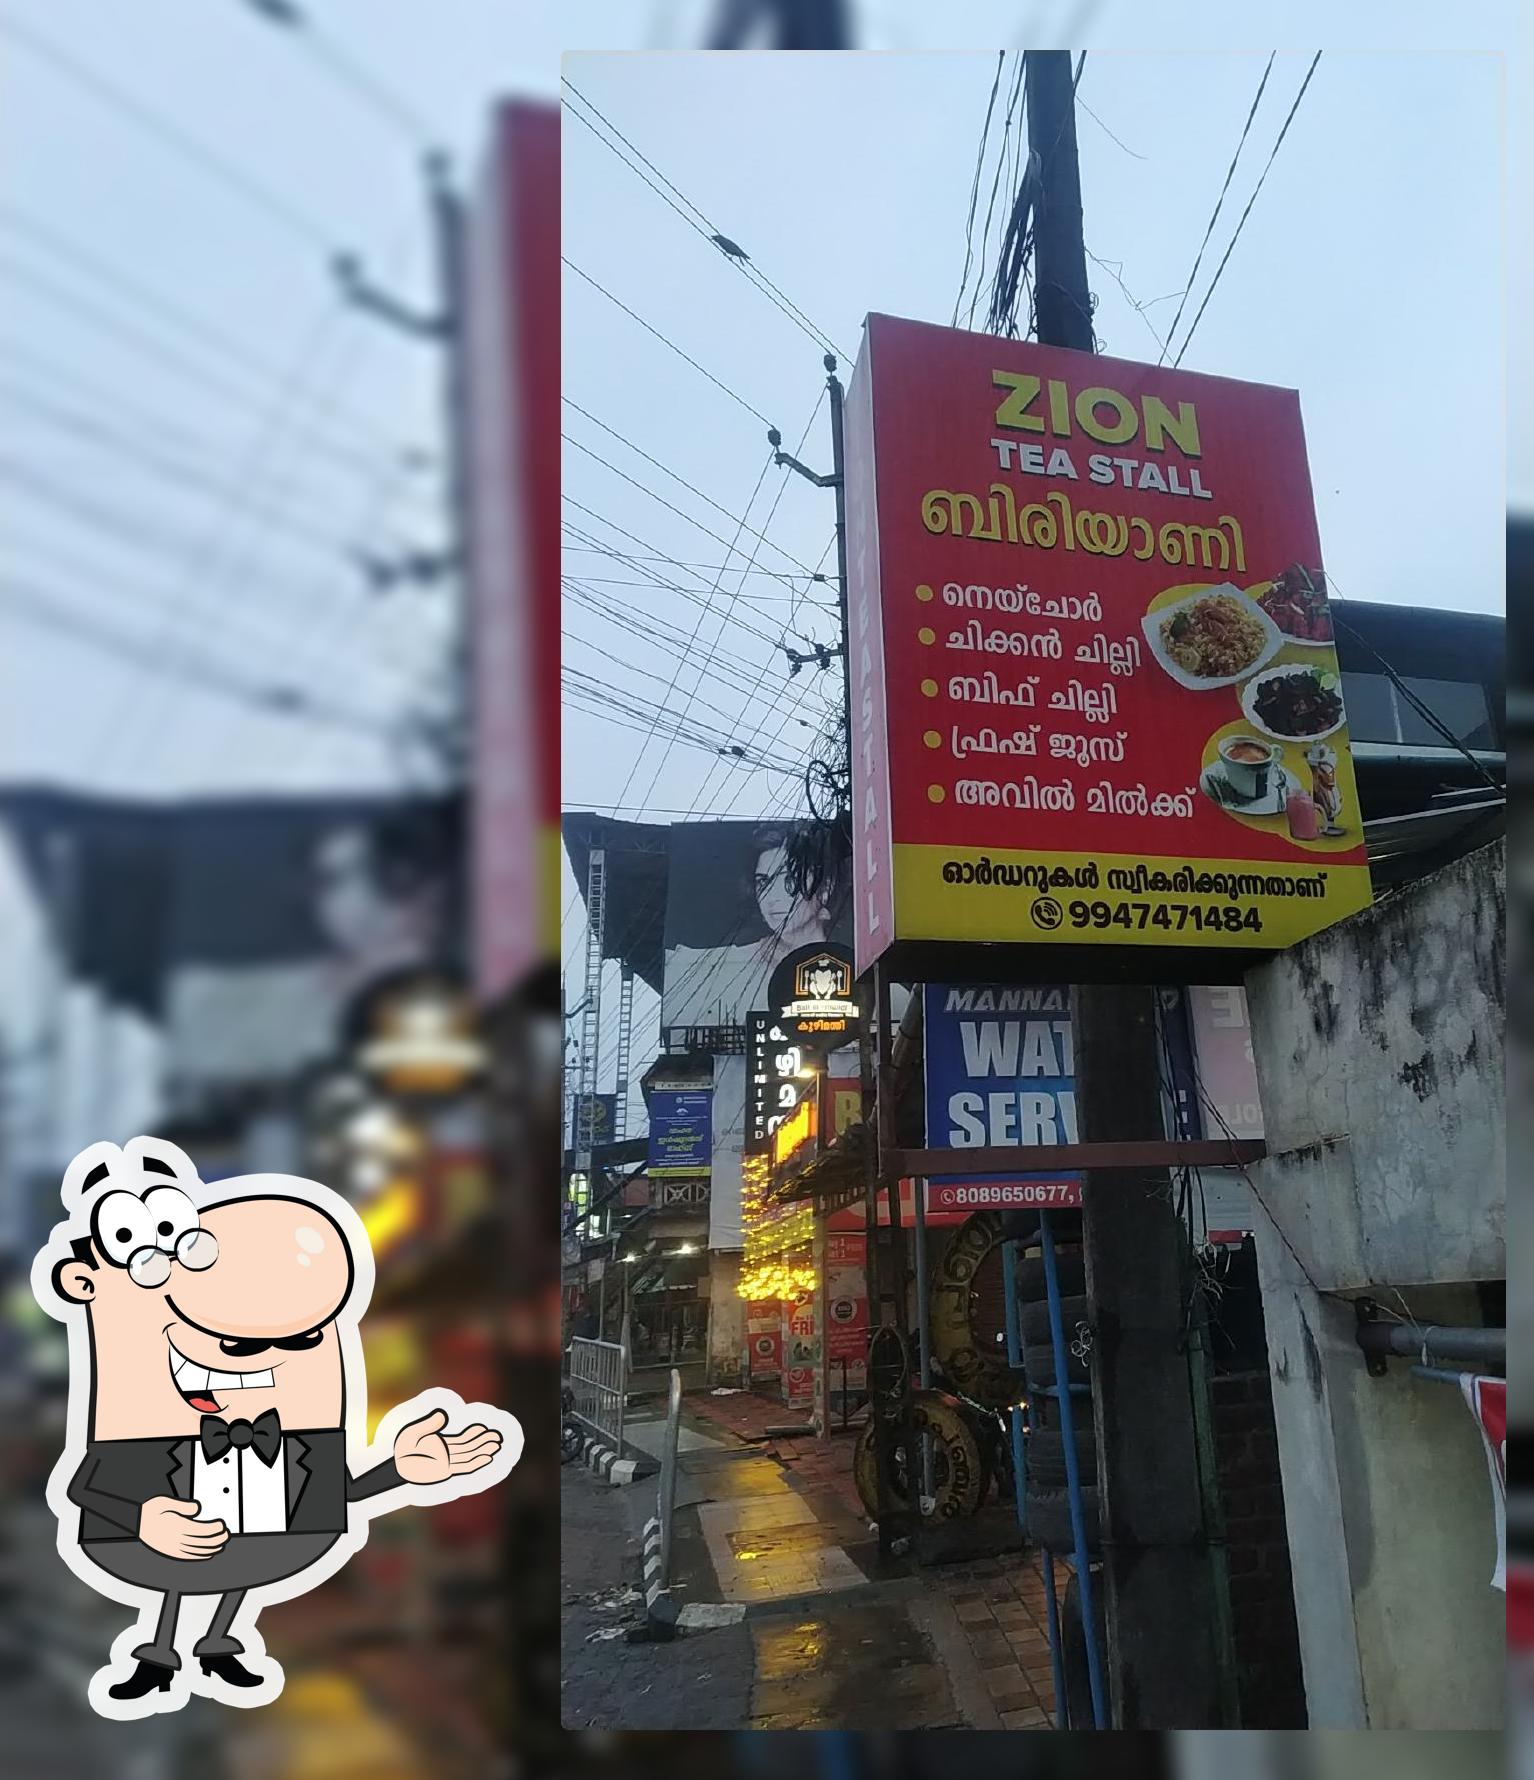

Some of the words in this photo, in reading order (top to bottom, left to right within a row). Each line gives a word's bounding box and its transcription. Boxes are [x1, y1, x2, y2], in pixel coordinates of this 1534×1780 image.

[992, 369, 1203, 458] ZION
[990, 438, 1079, 480] TEA
[1089, 453, 1212, 499] STALL
[921, 483, 1247, 573] ബിരിയാണി
[942, 581, 1104, 622] നെയ്ചോർ
[945, 619, 1063, 660] ചിക്കൻ
[1073, 633, 1142, 677] ചില്ലി
[948, 671, 1041, 707] ബിഫ്
[1047, 679, 1118, 724] ചില്ലി
[952, 723, 1042, 759] ഫ്രഷ്
[861, 687, 881, 936] STALL
[955, 775, 1076, 812] അവിൽ
[1086, 781, 1196, 819] മിൽക്ക്
[942, 856, 1100, 894] ഓർഡറുകൾ
[1107, 863, 1328, 901] സ്വീകരിക്കുന്നതാണ്
[1069, 900, 1263, 933] 9947471484
[754, 1020, 767, 1139] UNLIMITED
[955, 1184, 1075, 1205] 8089650677,
